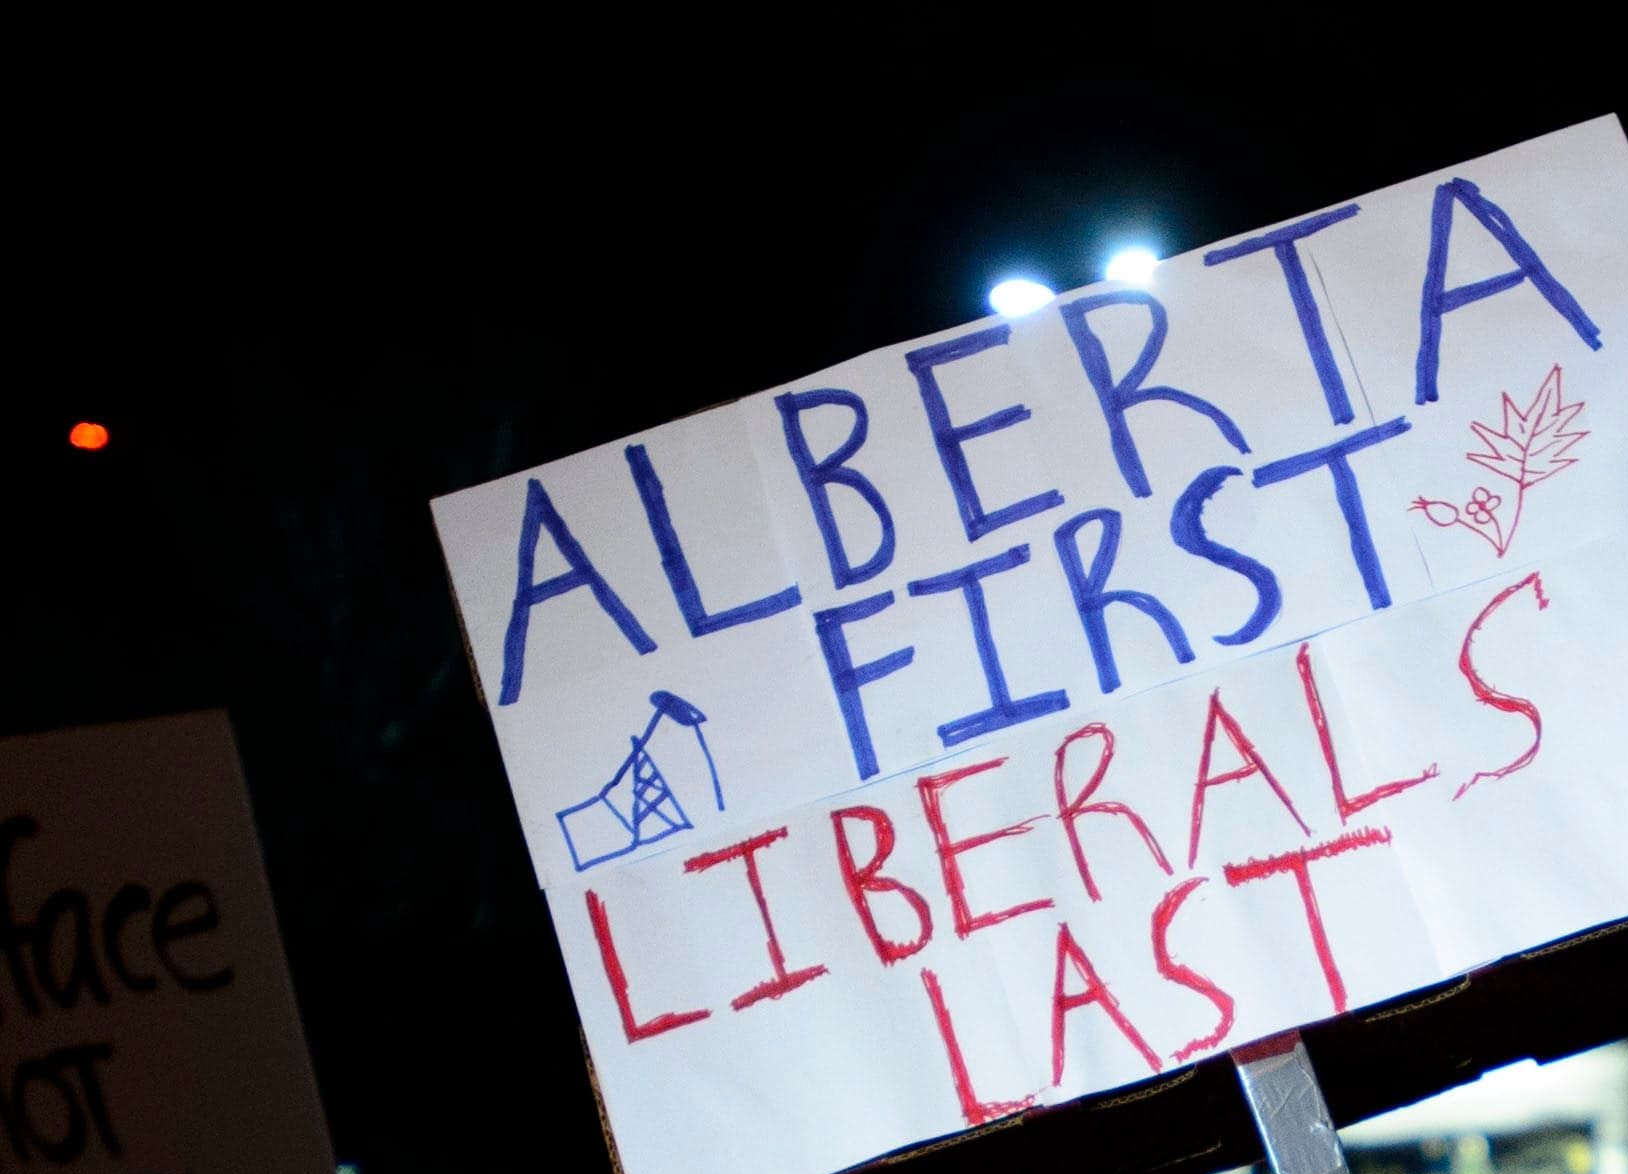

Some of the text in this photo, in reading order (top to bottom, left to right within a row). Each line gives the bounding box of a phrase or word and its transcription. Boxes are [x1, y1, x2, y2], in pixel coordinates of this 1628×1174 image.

[499, 178, 1602, 706] ALBERTA
[814, 416, 1412, 781] FIRST
[585, 571, 1550, 1044] LIBERALS
[920, 826, 1393, 1127] LAST
